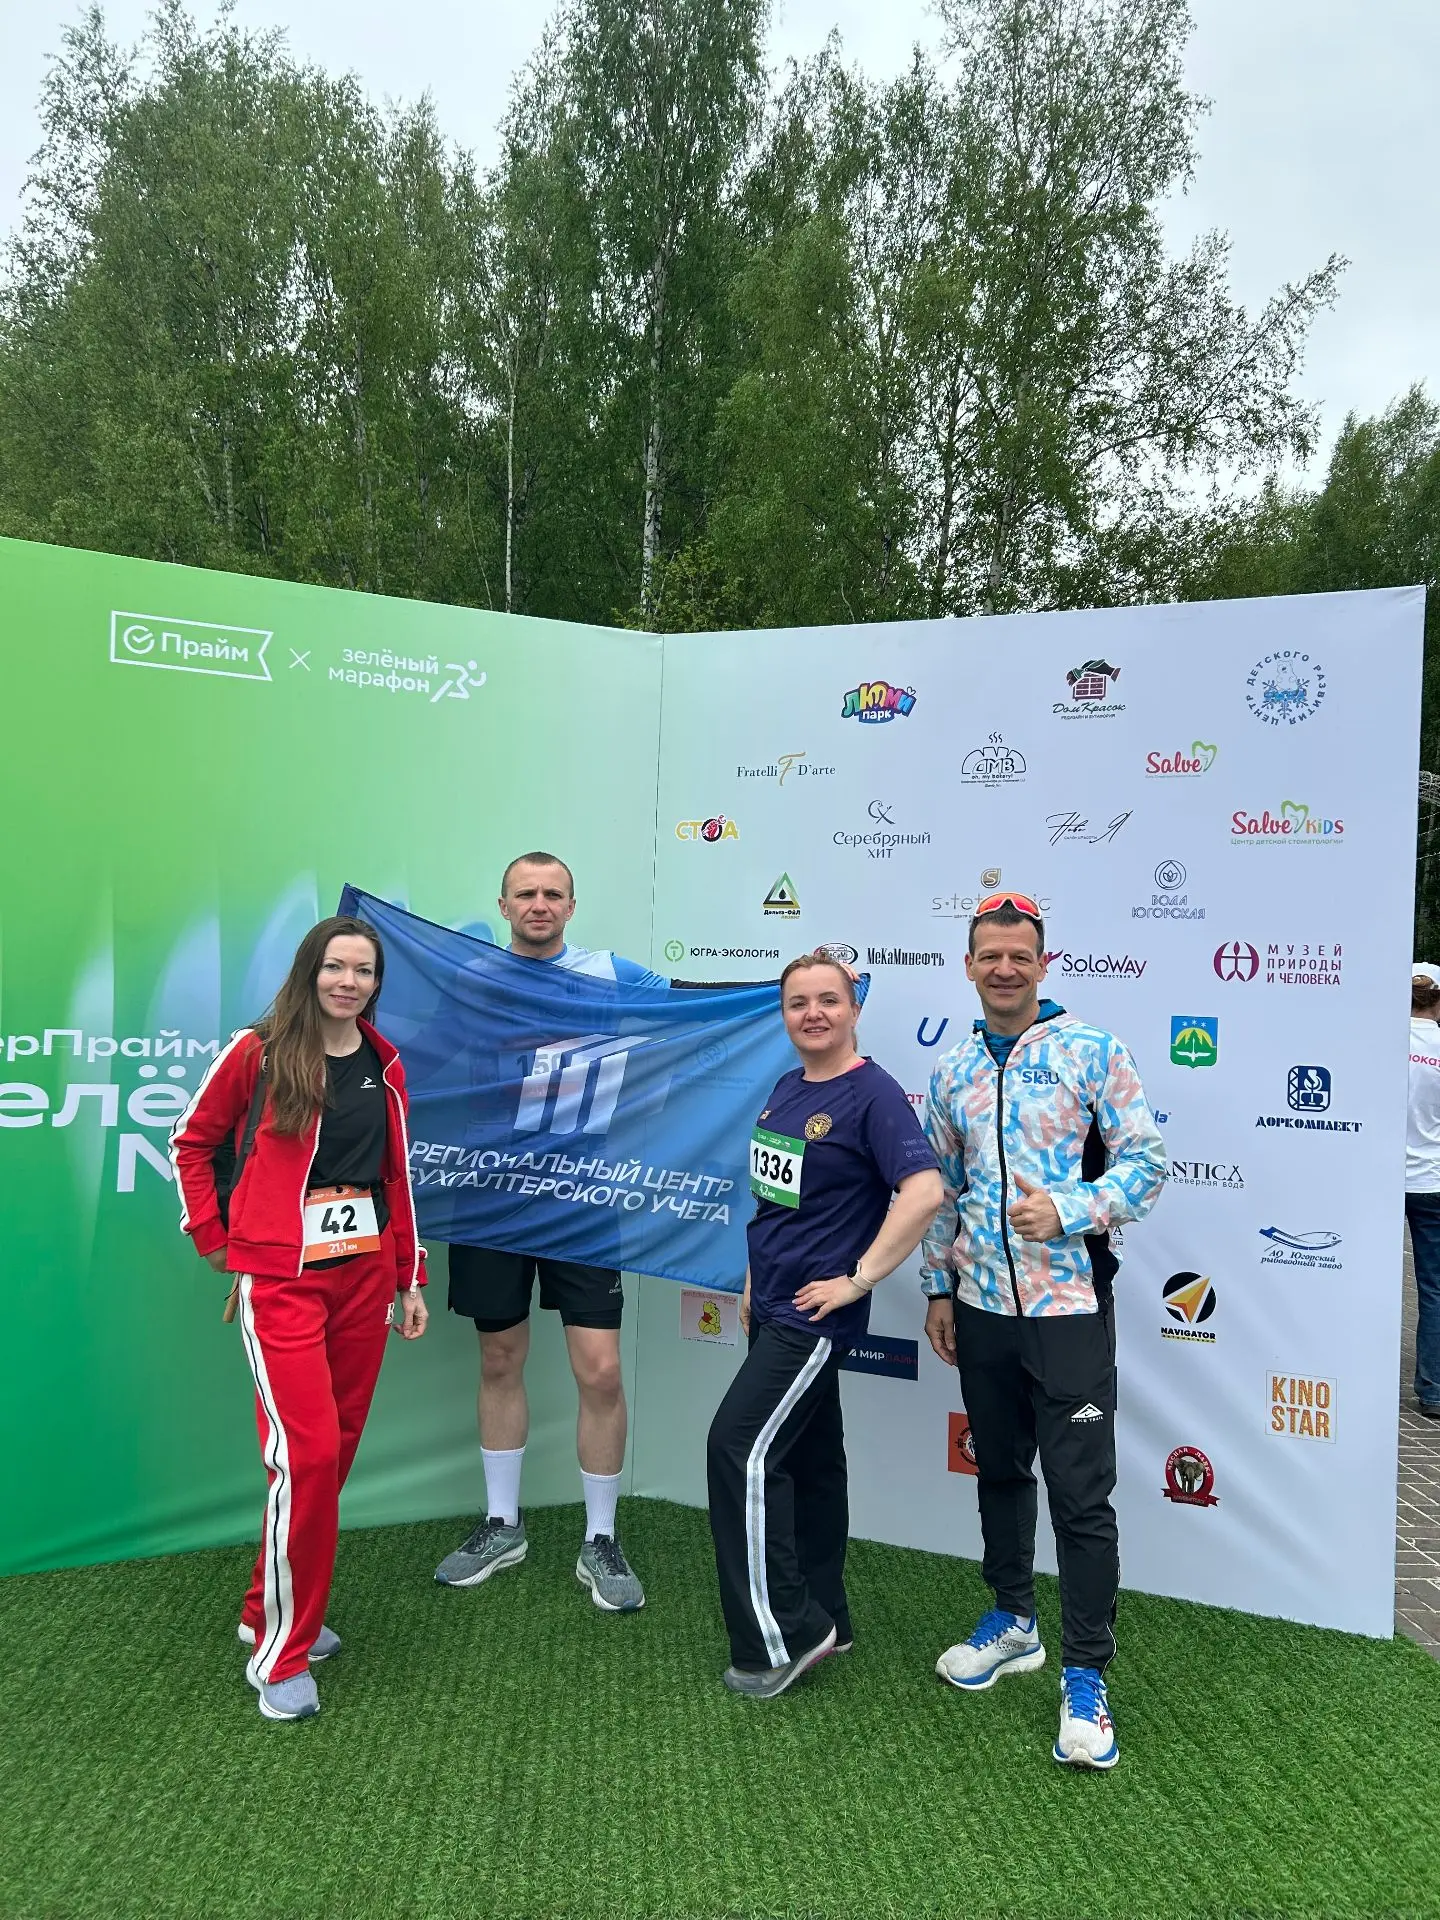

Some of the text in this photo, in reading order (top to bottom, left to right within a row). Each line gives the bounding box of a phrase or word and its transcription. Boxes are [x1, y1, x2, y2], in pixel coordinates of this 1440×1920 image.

[161, 632, 249, 663] Прайм
[342, 646, 440, 676] зелёный
[328, 666, 431, 695] марафон
[1246, 650, 1328, 727] ЦЕНТР ДЕТСКОГО РАЗВИТИЯ
[862, 708, 893, 722] парк
[737, 765, 779, 778] Fratelli
[1145, 751, 1202, 775] Salve
[1231, 811, 1293, 835] Salve
[833, 831, 932, 849] Серебряный
[1131, 906, 1206, 920] ЮГОРСКАЯ
[690, 946, 779, 959] ЮГРА-ЭКОЛОГИЯ
[866, 947, 945, 967] МеКаМинефть
[1267, 943, 1343, 956] МУЗЕЙ
[1267, 958, 1342, 971] ПРИРОДЫ
[1267, 972, 1341, 985] И ЧЕЛОВЕКА
[0, 1029, 219, 1062] рПрайм
[1255, 1115, 1363, 1134] ДОРКОМПЛЕКТ
[408, 1140, 735, 1198] РЕГИОНАЛЬНЫЙ ЦЕНТР
[753, 1147, 794, 1186] 1336
[1173, 1178, 1218, 1188] северная
[1222, 1179, 1245, 1189] вода
[320, 1204, 359, 1236] 42
[649, 1195, 731, 1226] УЧЕТА
[1260, 1256, 1343, 1271] рыбоводный завод
[1269, 1250, 1336, 1263] АО Югорский
[1161, 1327, 1216, 1340] NAVIGATOR
[1272, 1376, 1331, 1409] KINO
[1271, 1405, 1330, 1439] STAR
